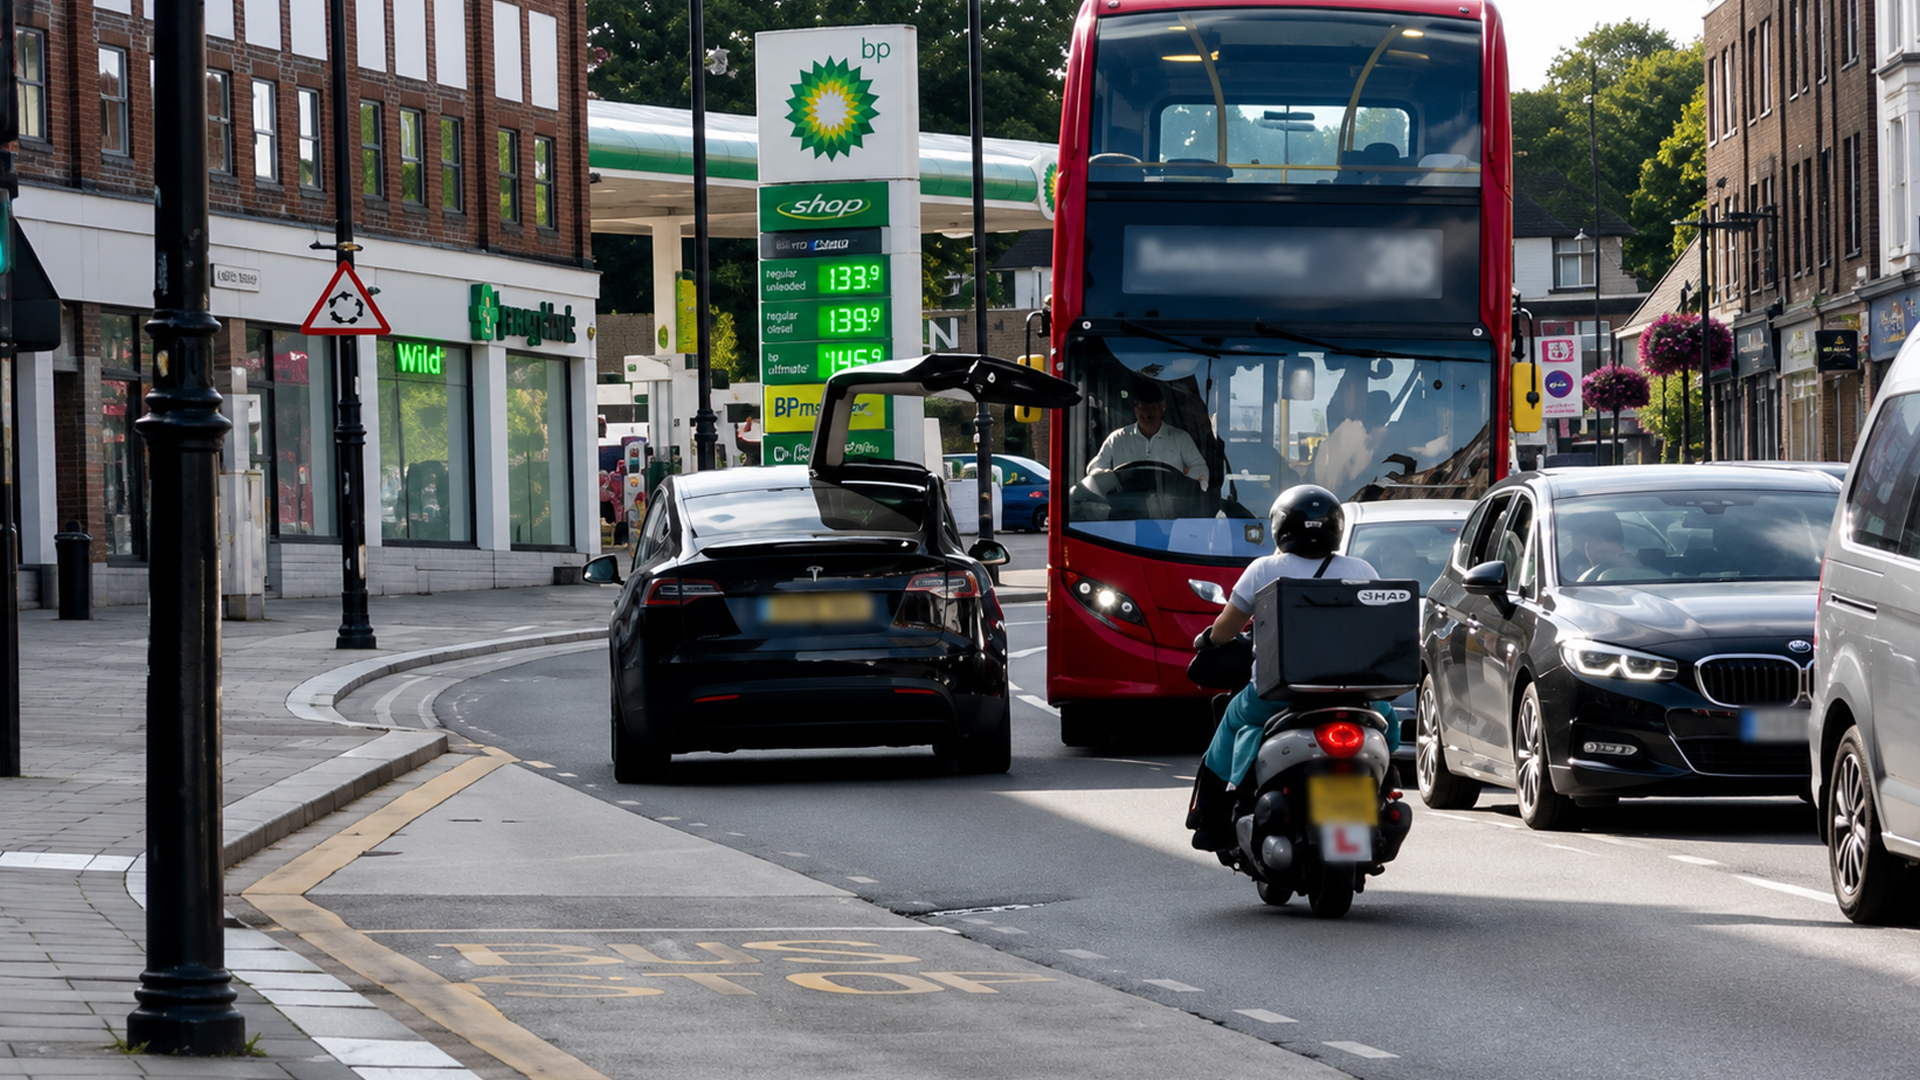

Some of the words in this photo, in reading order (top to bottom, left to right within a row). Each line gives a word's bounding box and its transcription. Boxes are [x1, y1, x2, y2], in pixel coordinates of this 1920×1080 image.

[861, 37, 891, 64] bp
[790, 193, 864, 218] shop
[434, 940, 921, 966] BUS
[470, 971, 1058, 998] STOP
